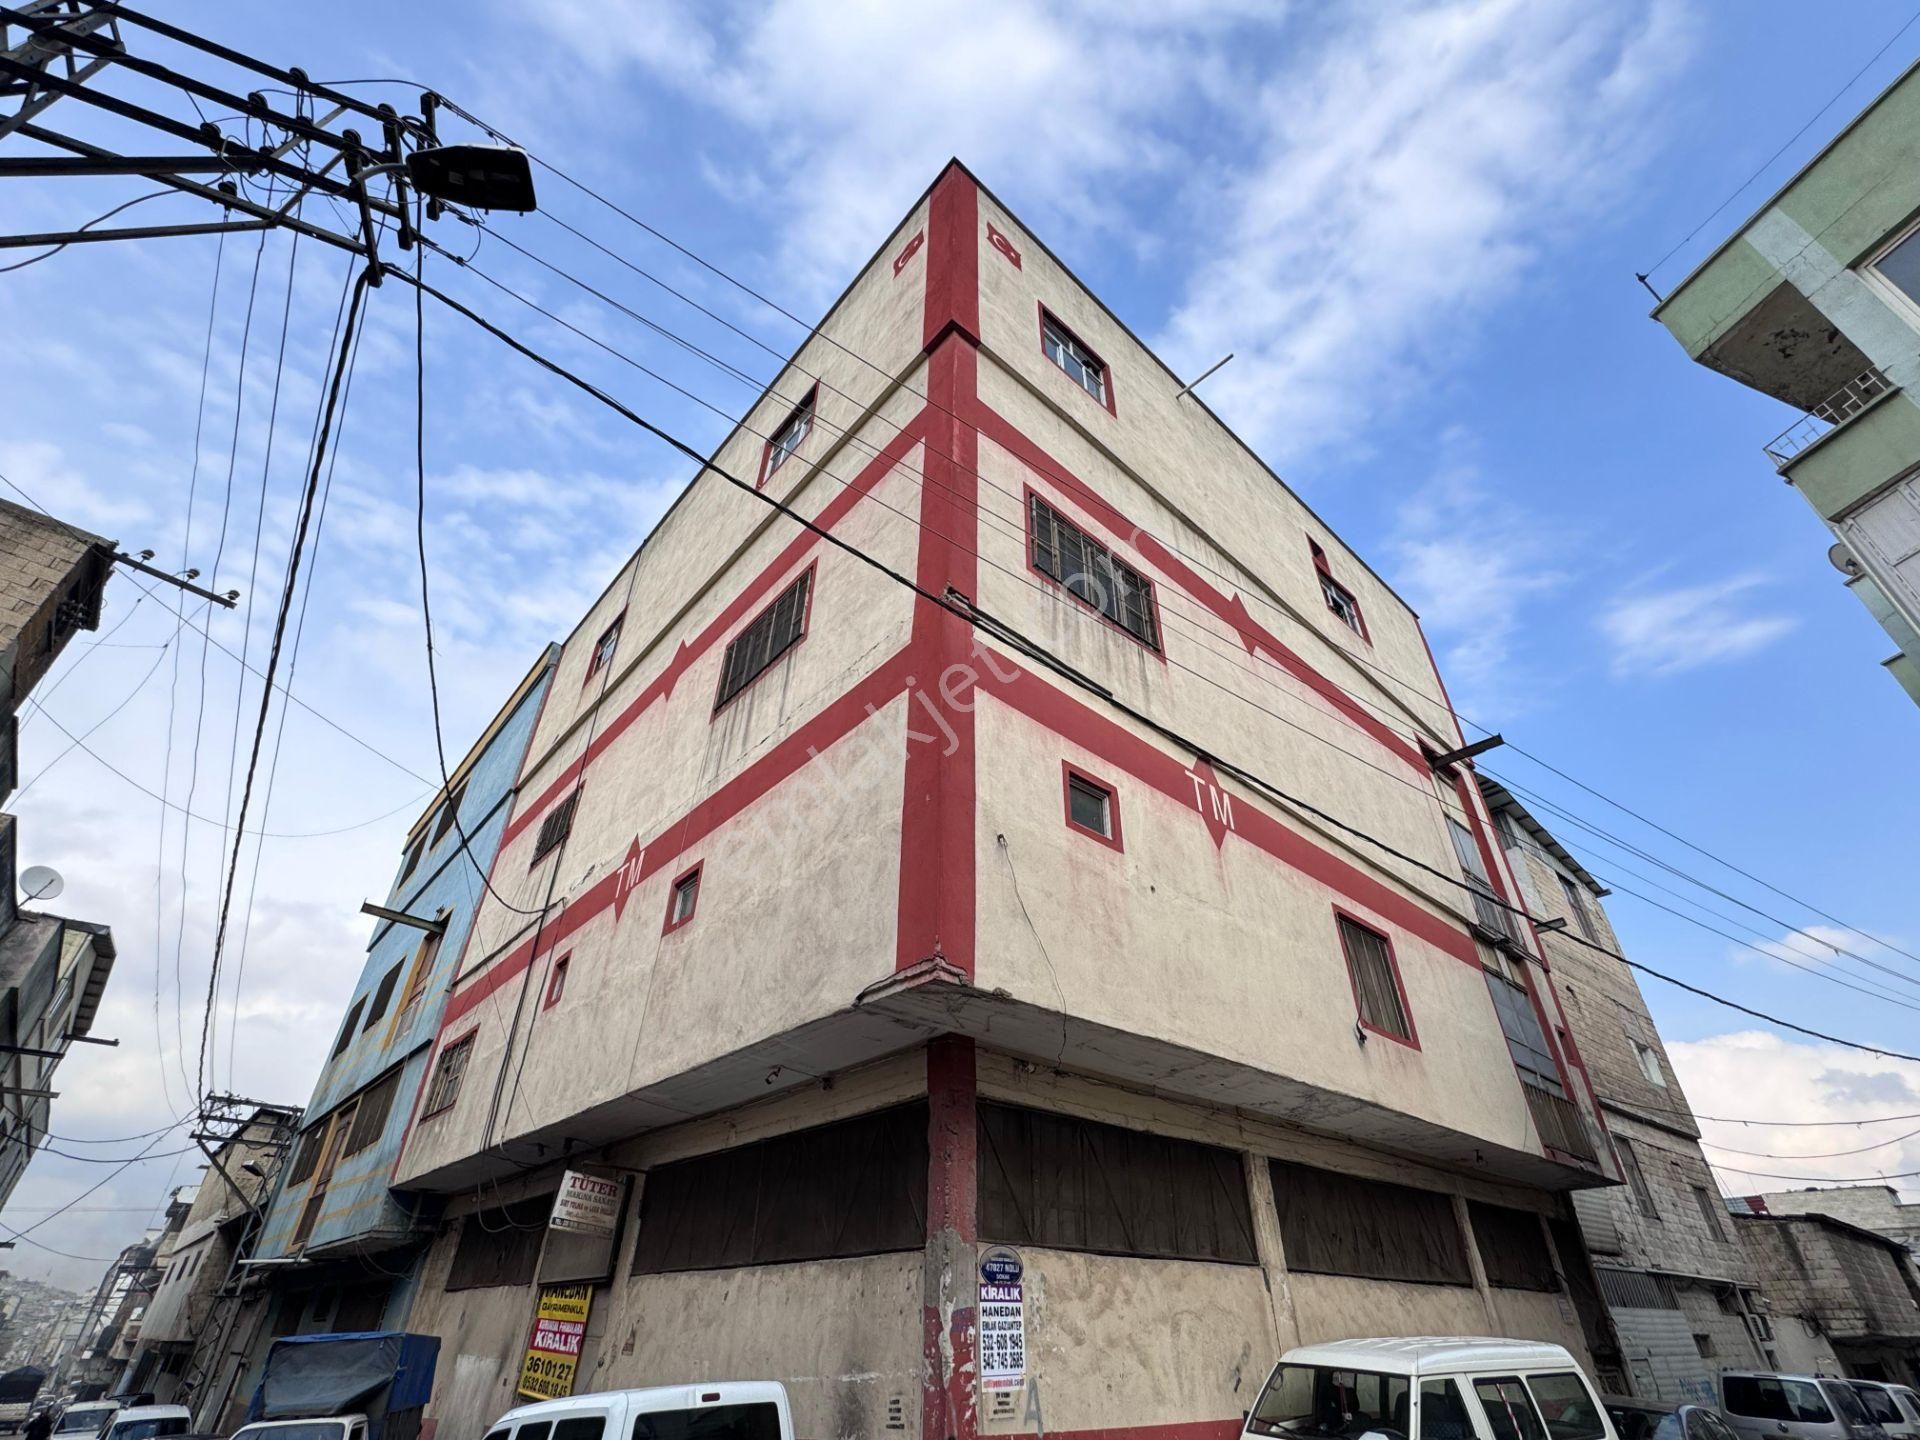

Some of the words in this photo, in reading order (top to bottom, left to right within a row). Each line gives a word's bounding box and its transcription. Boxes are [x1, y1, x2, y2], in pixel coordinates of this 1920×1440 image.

[1185, 769, 1235, 831] TM
[615, 850, 645, 899] TM
[570, 1175, 618, 1196] TÜTER
[981, 1285, 1021, 1300] KİRALIK
[982, 1306, 1021, 1317] HANEDAN
[982, 1321, 997, 1331] EMLAK
[527, 1356, 572, 1381] 3610127
